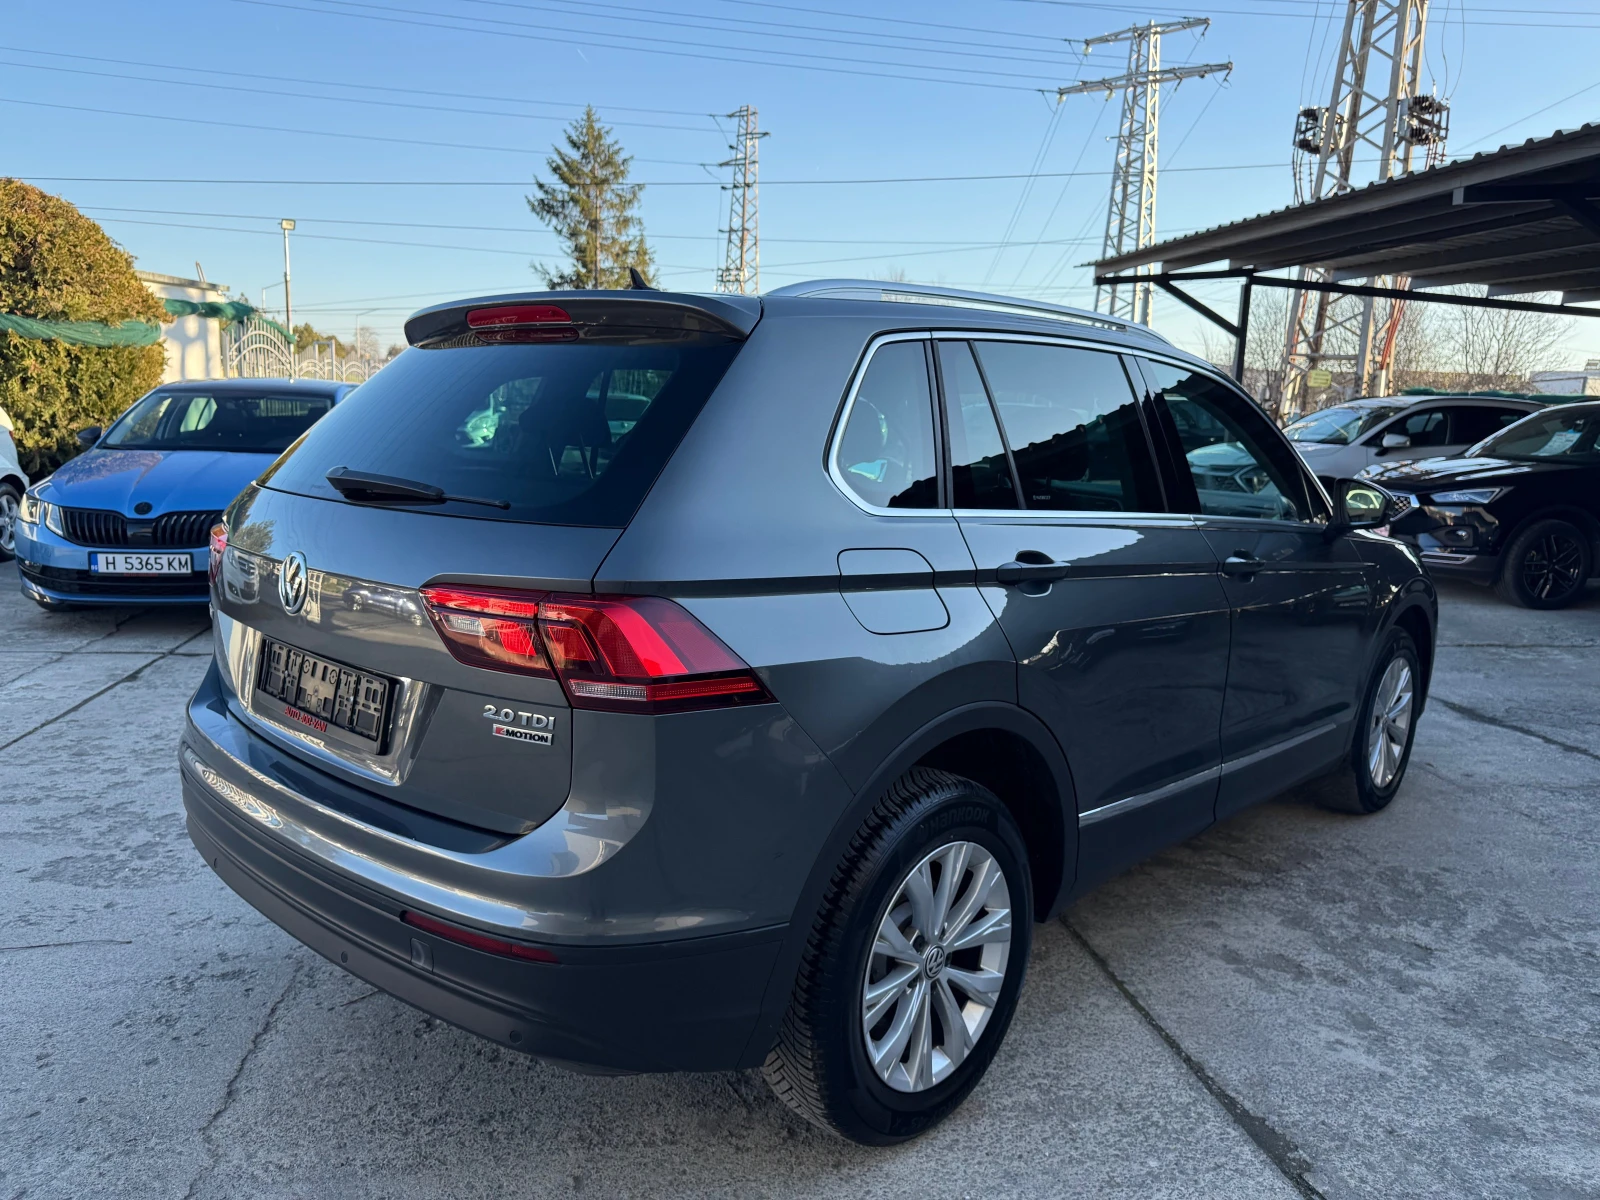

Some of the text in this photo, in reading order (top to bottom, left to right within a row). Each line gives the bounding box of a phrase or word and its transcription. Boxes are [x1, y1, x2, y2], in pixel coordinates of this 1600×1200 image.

[105, 556, 189, 571] H 5365 KM
[482, 704, 556, 730] 2.0 TDI
